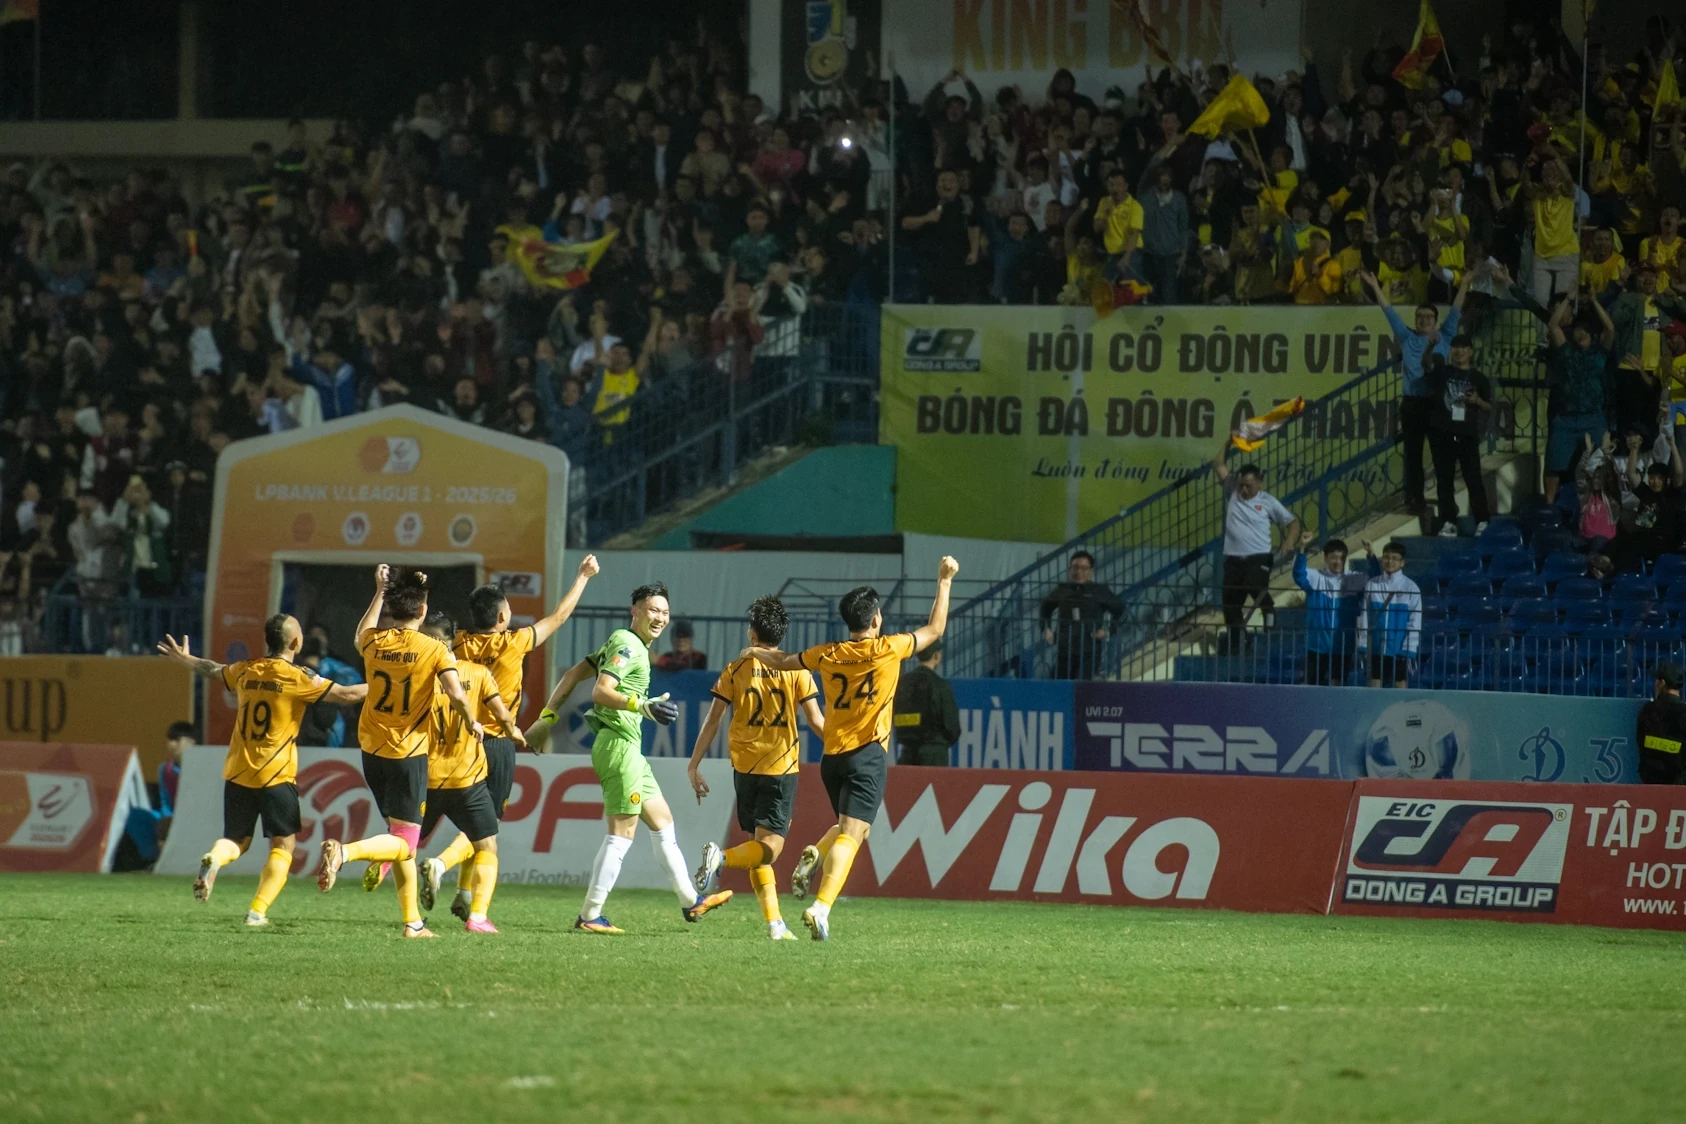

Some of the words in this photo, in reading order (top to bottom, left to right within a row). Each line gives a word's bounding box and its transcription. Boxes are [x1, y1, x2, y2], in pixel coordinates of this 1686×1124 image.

[1026, 324, 1093, 380] HỘI
[1109, 315, 1164, 375] CỔ
[1177, 324, 1289, 382] ĐỘNG
[917, 386, 1022, 436] BÓNG
[1036, 387, 1089, 437] ĐÁ
[1105, 388, 1215, 440] ĐÔNG
[373, 670, 412, 717] 21
[744, 688, 788, 728] 22
[831, 671, 878, 710] 24
[1103, 707, 1124, 719] 2.07
[240, 701, 272, 743] 19
[949, 696, 1064, 771] HÀNH
[1086, 721, 1330, 775] TERRA
[1385, 802, 1436, 818] EIC
[1584, 799, 1657, 857] TẬP
[866, 781, 1220, 900] Wika
[1345, 878, 1425, 903] DONG
[1427, 883, 1449, 905] A
[1454, 884, 1554, 909] GROUP
